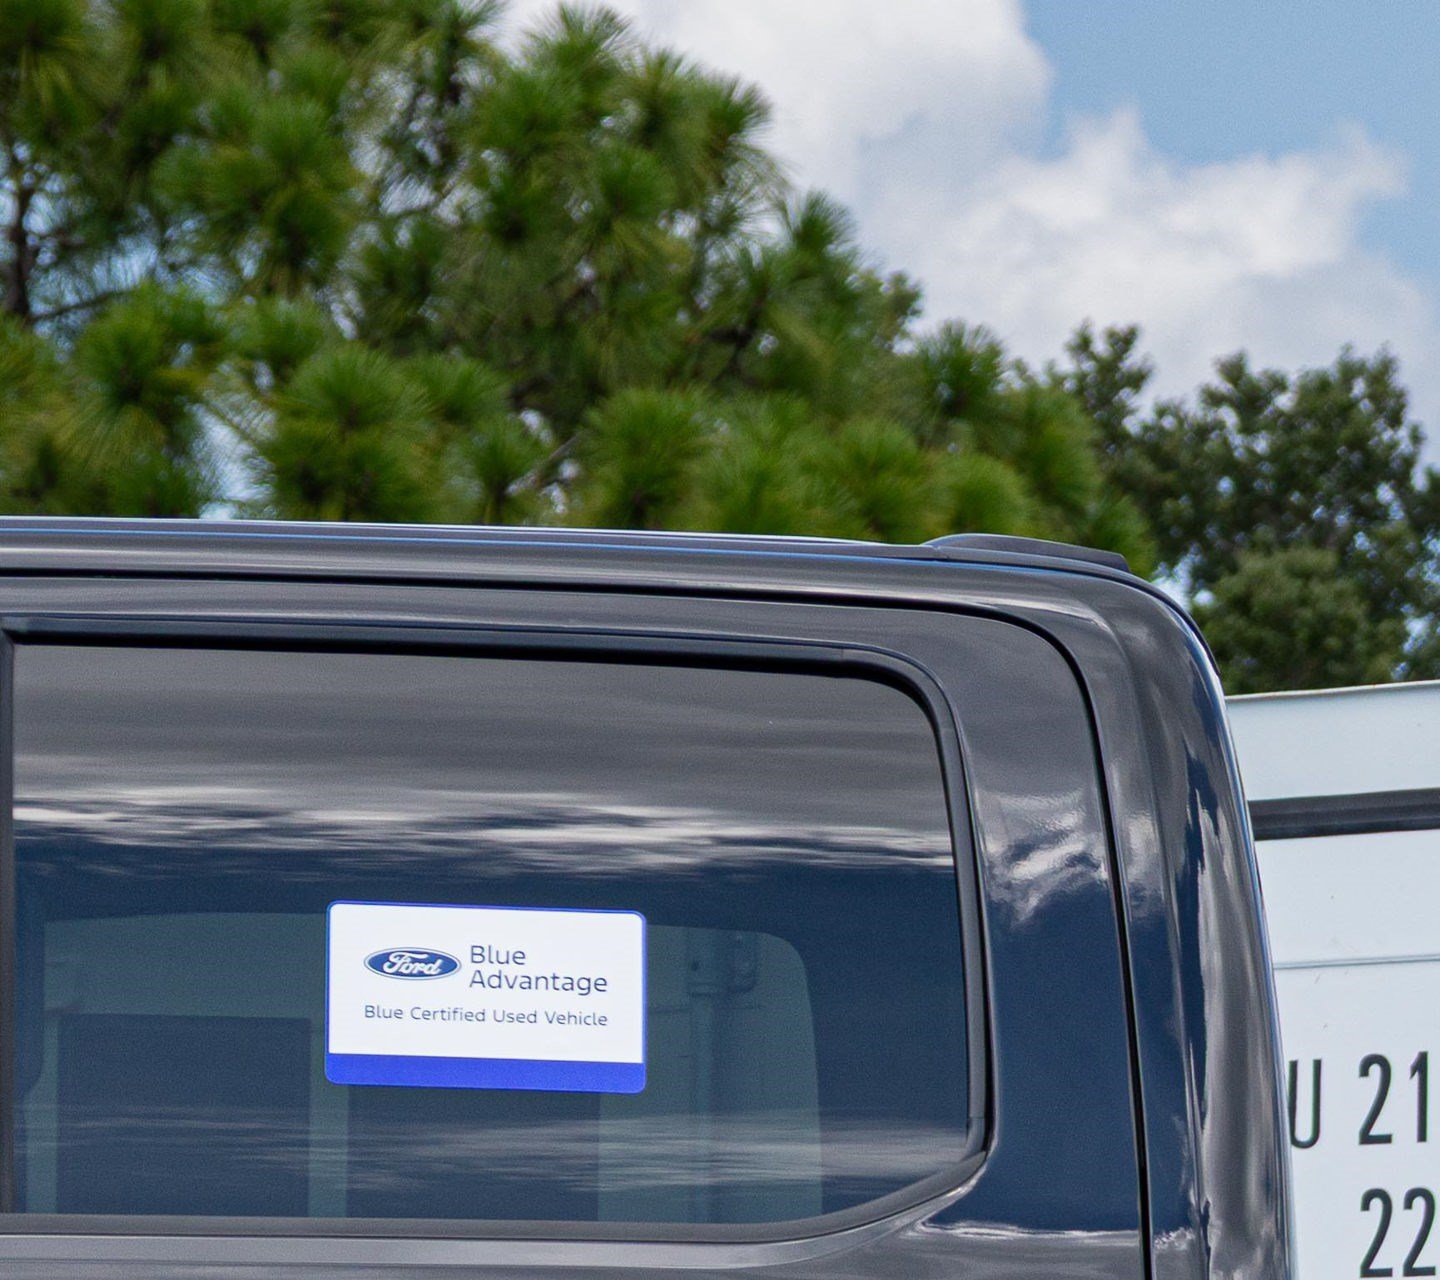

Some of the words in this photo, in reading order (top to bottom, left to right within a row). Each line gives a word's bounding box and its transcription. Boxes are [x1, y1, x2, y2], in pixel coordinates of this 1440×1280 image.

[382, 950, 445, 976] Ford
[469, 944, 527, 966] Blue
[468, 970, 609, 996] Advantage
[364, 1004, 404, 1021] Blue
[410, 1006, 486, 1023] Certified
[492, 1009, 538, 1024] Used
[544, 1010, 609, 1027] Vehicle
